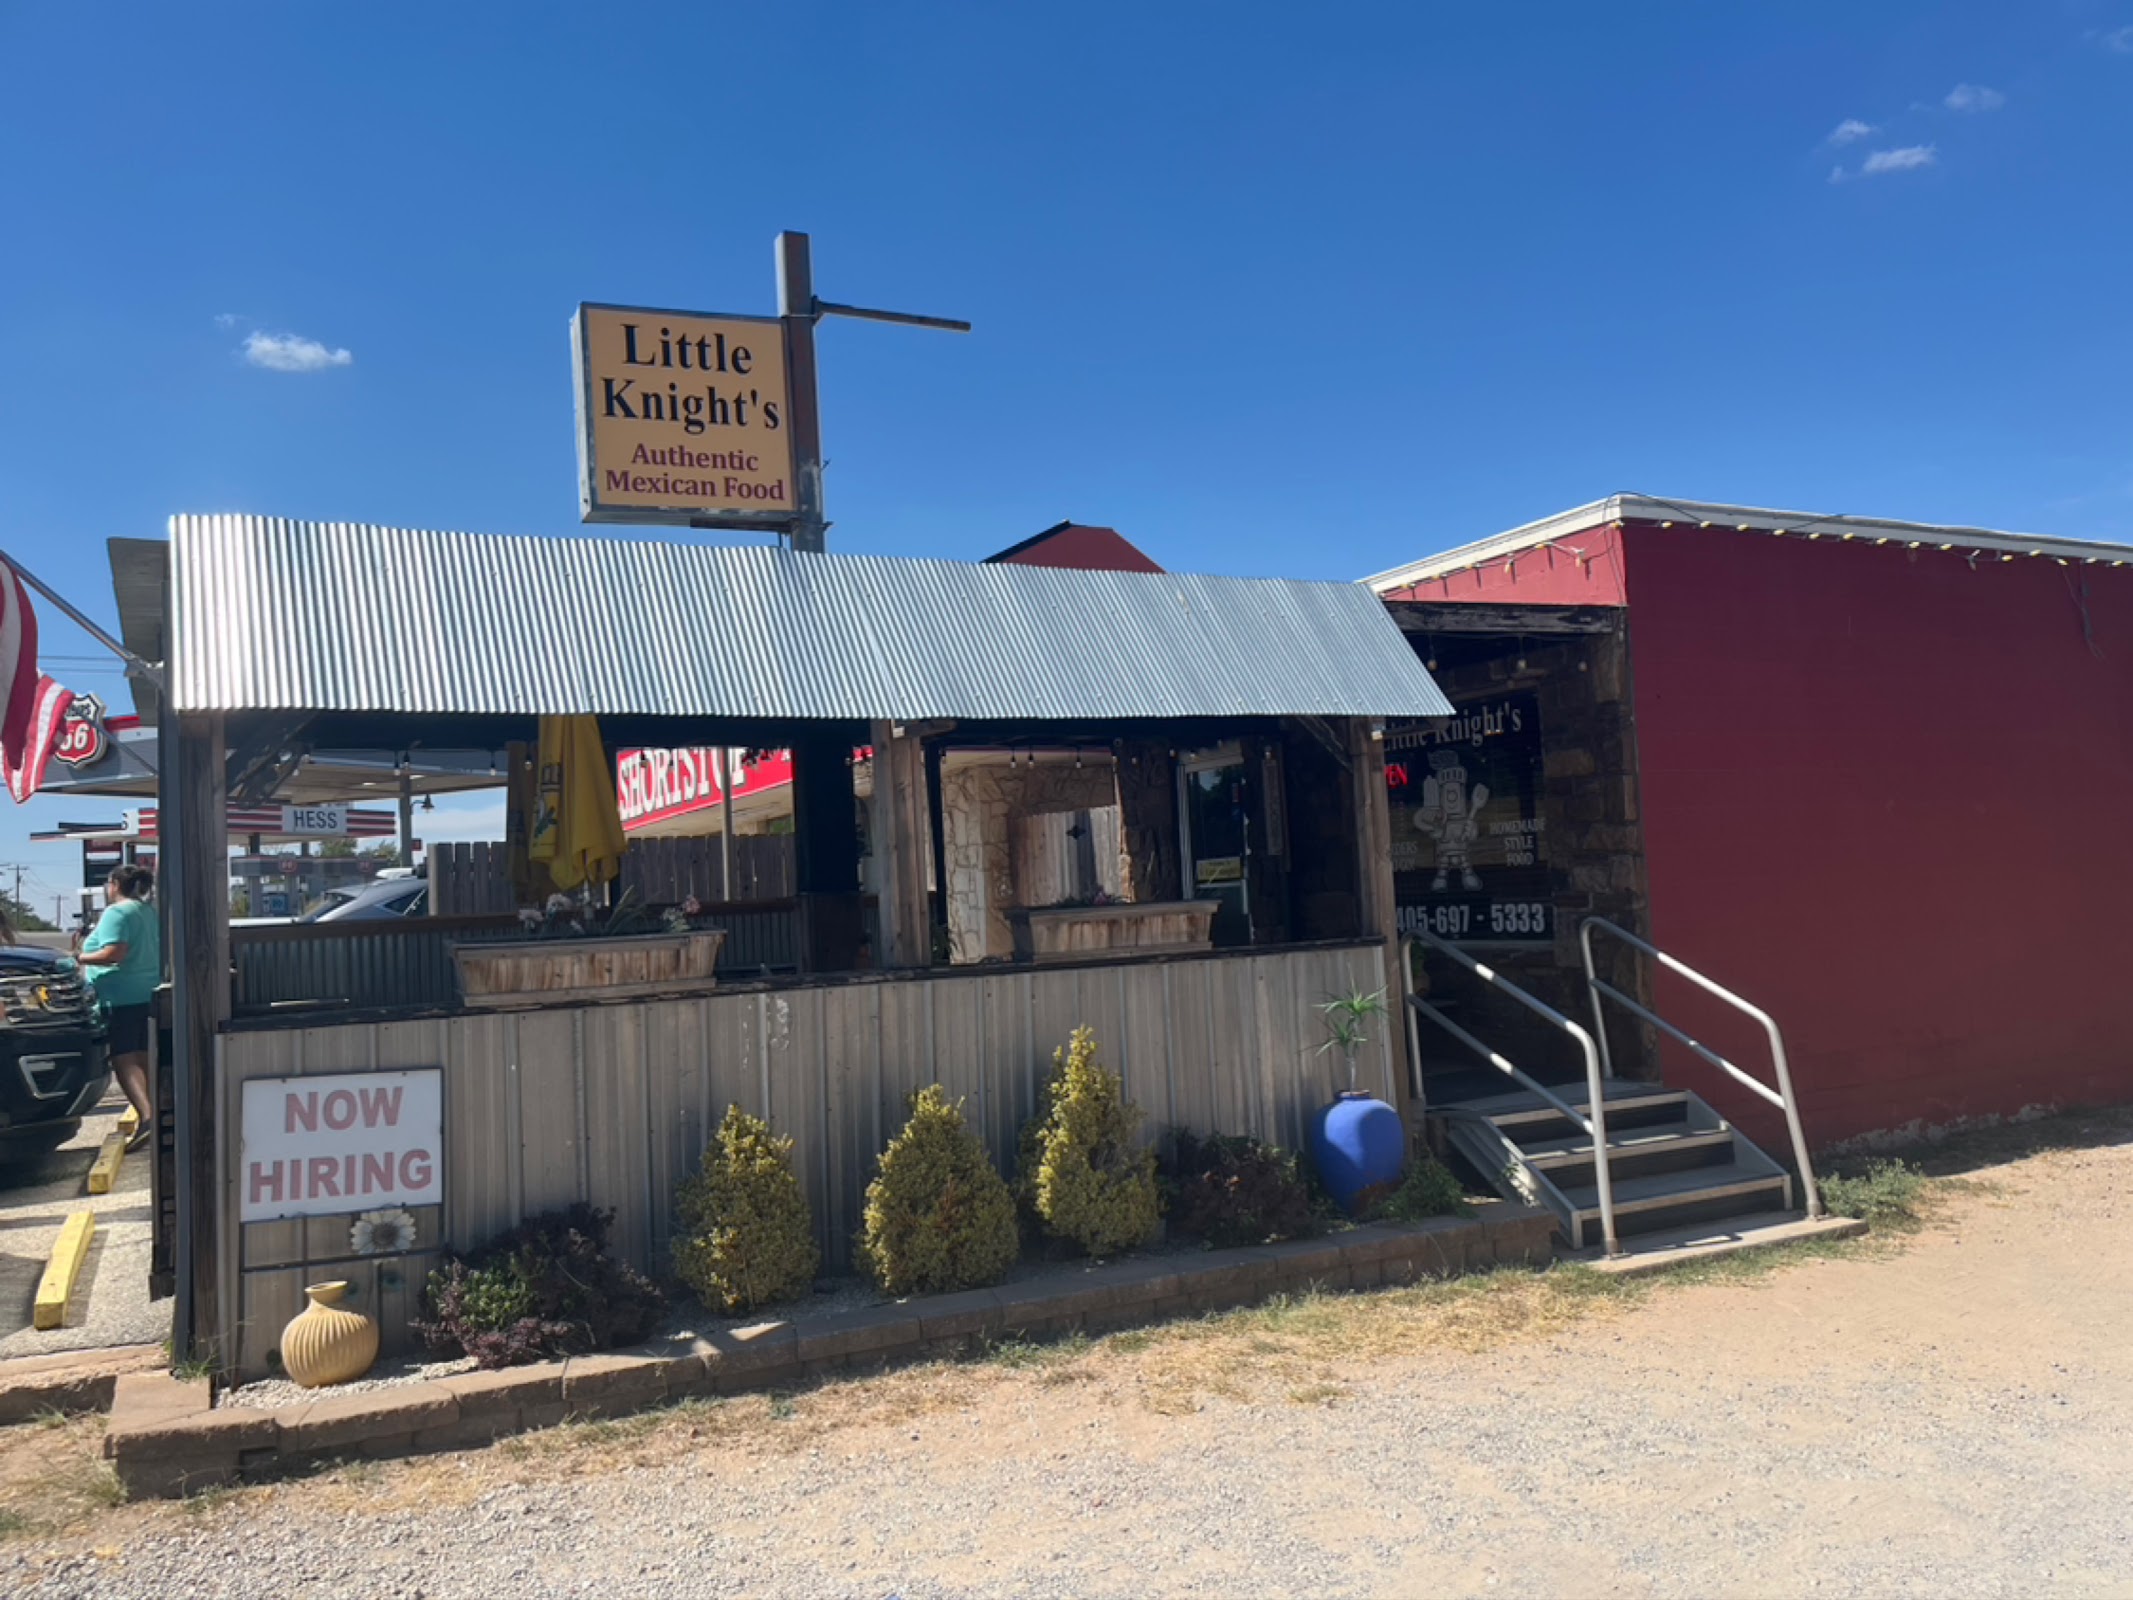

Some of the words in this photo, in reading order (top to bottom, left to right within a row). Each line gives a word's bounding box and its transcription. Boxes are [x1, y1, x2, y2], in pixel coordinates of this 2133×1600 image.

[621, 323, 752, 375] Little
[601, 377, 780, 435] Knight's
[631, 442, 759, 472] Authentic
[605, 469, 716, 497] Mexican
[723, 476, 785, 500] Food
[293, 810, 338, 829] HESS
[1504, 835, 1535, 850] STYLE
[1491, 903, 1545, 933] 5333
[284, 1086, 403, 1133] NOW
[249, 1149, 432, 1204] HIRING
